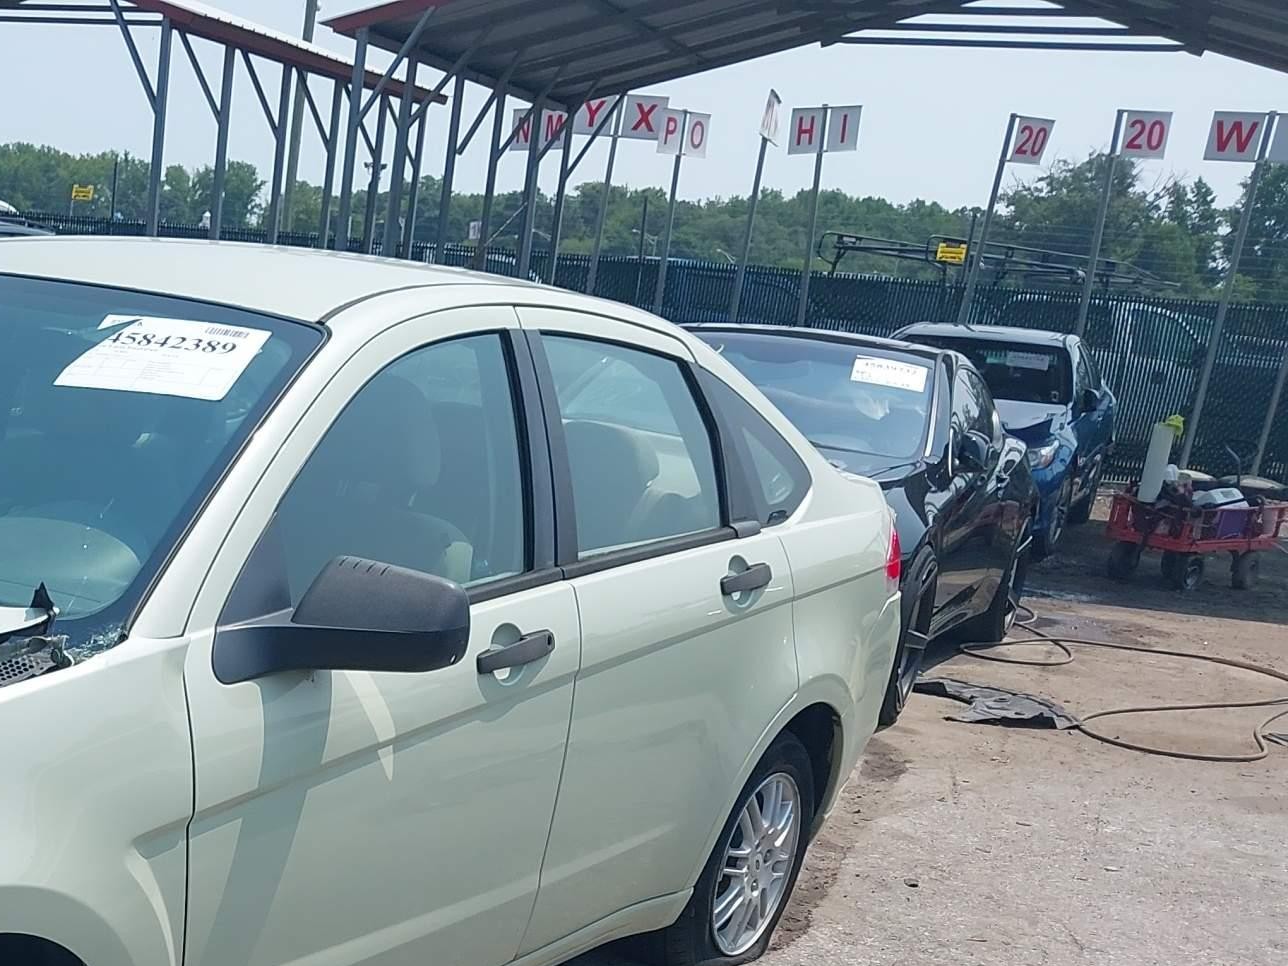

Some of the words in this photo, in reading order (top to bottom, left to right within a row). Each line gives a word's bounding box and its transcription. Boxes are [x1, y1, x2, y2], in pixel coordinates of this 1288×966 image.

[584, 100, 606, 127] Y
[631, 102, 658, 132] X
[663, 116, 678, 145] P
[796, 115, 815, 146] H
[1014, 124, 1048, 157] 20
[1125, 119, 1165, 151] 20
[1215, 119, 1259, 153] W
[107, 331, 238, 355] 45842389
